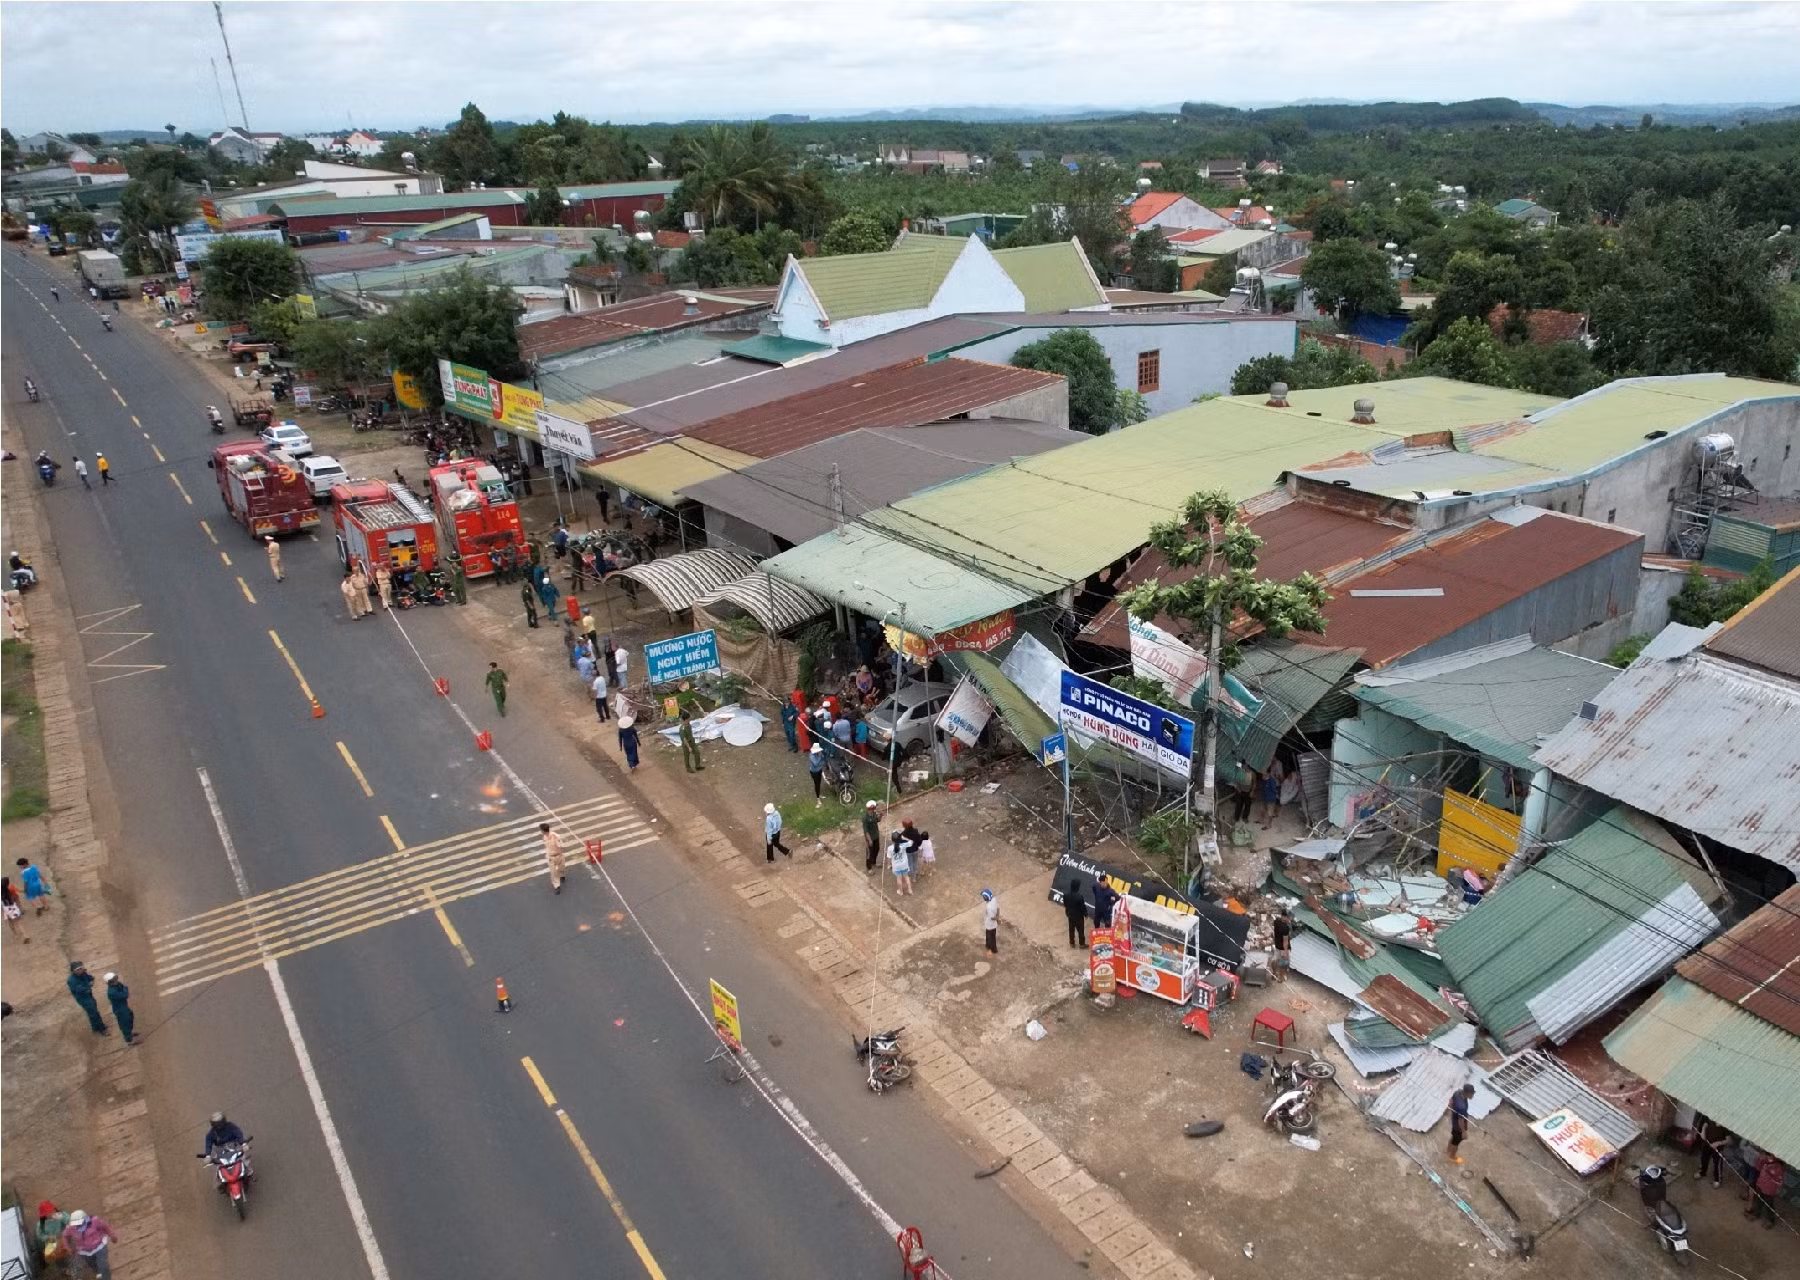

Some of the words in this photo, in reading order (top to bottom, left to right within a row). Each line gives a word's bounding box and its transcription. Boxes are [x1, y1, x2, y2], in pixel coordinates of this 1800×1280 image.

[649, 641, 684, 657] MƯƠNG
[687, 633, 712, 648] NƯỚC
[657, 655, 682, 669] NGUY
[685, 646, 710, 662] HIỂM
[682, 661, 706, 674] TRÁNH
[706, 660, 716, 669] XA
[1084, 693, 1151, 732] PINACO
[1548, 1119, 1585, 1147] THUỐC
